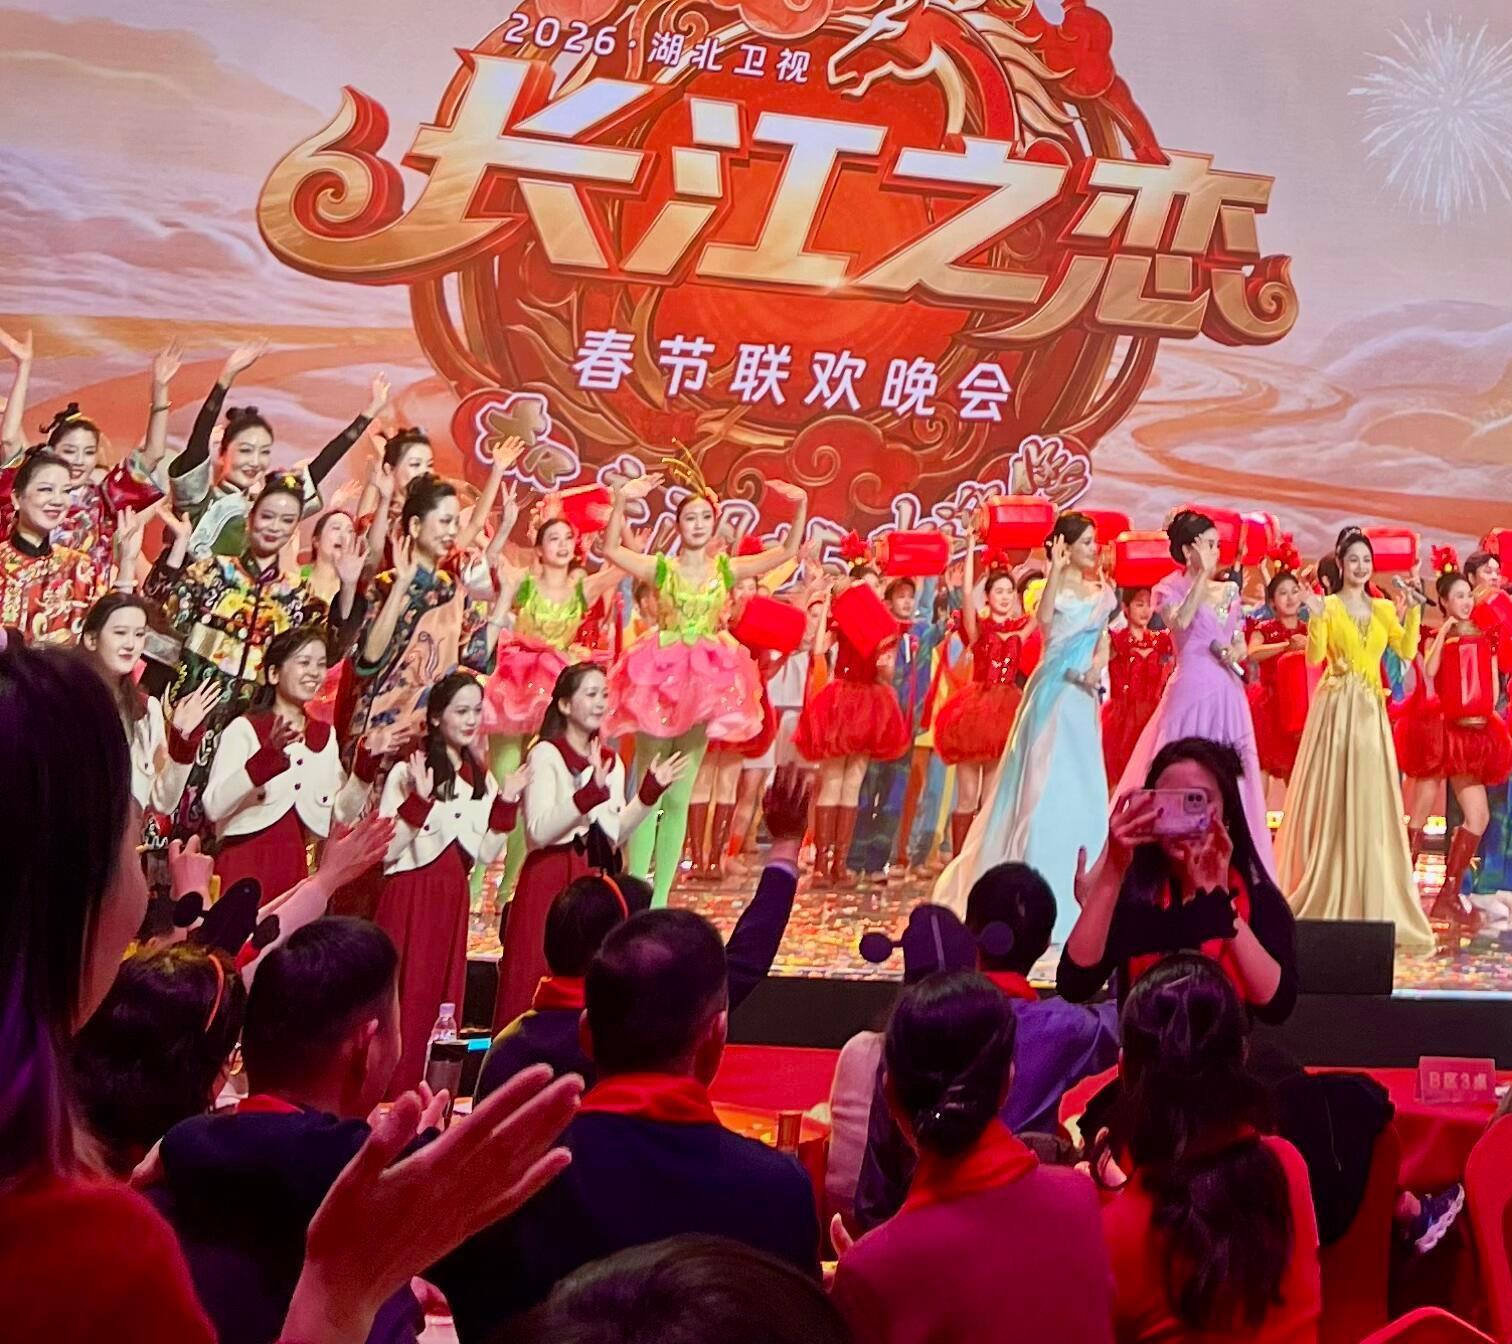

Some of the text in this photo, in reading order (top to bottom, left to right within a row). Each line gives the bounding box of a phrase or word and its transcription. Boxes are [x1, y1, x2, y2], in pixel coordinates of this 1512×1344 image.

[257, 48, 1300, 347] 长江之恋
[571, 327, 1013, 422] 春节联欢晚会
